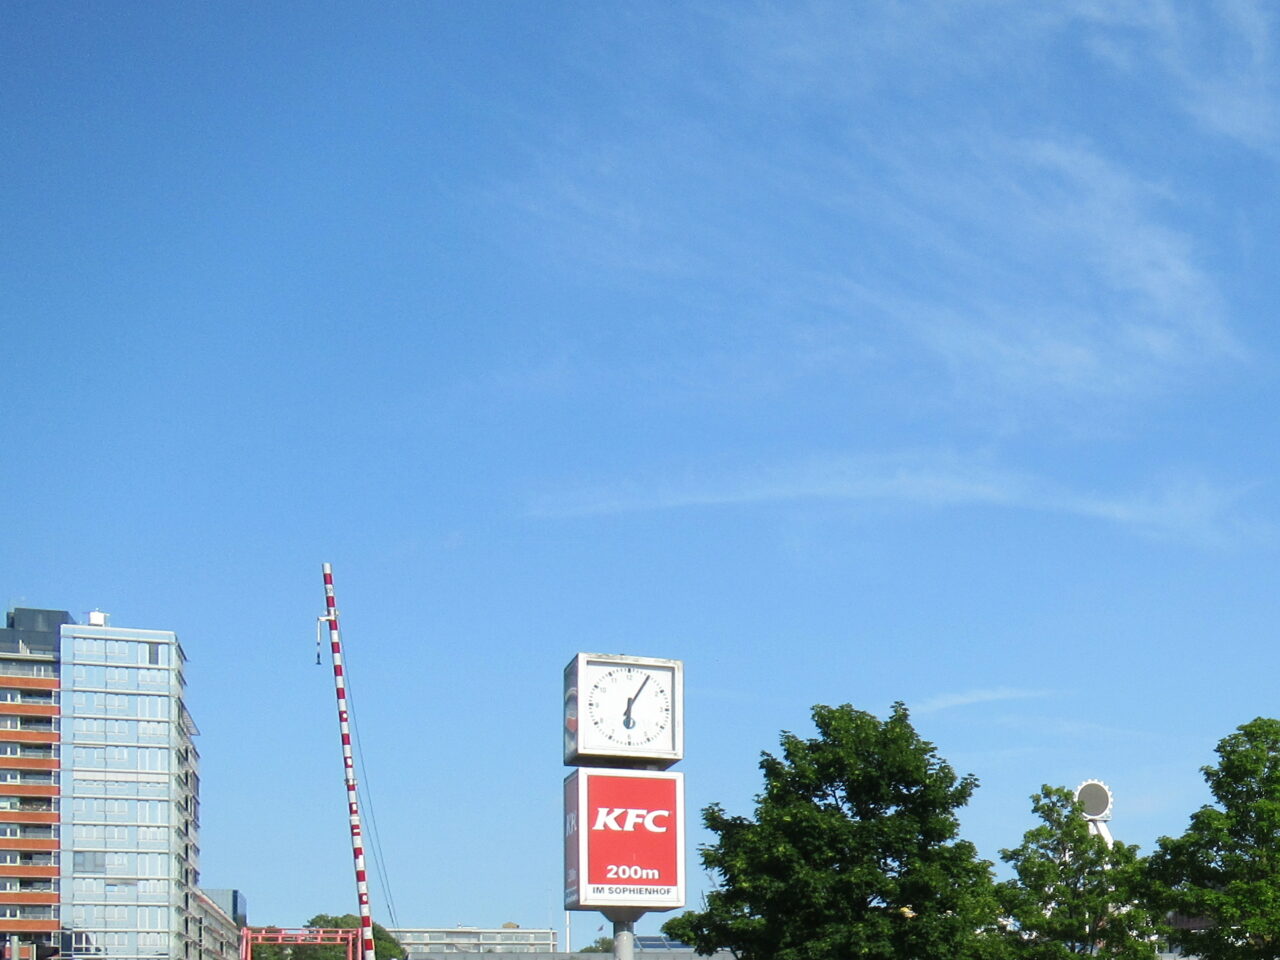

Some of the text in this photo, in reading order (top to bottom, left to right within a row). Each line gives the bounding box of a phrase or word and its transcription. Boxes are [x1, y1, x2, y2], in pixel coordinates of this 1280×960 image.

[592, 807, 670, 833] KFC
[606, 865, 660, 880] 200m
[592, 886, 672, 895] IM SOPHIENHOF
